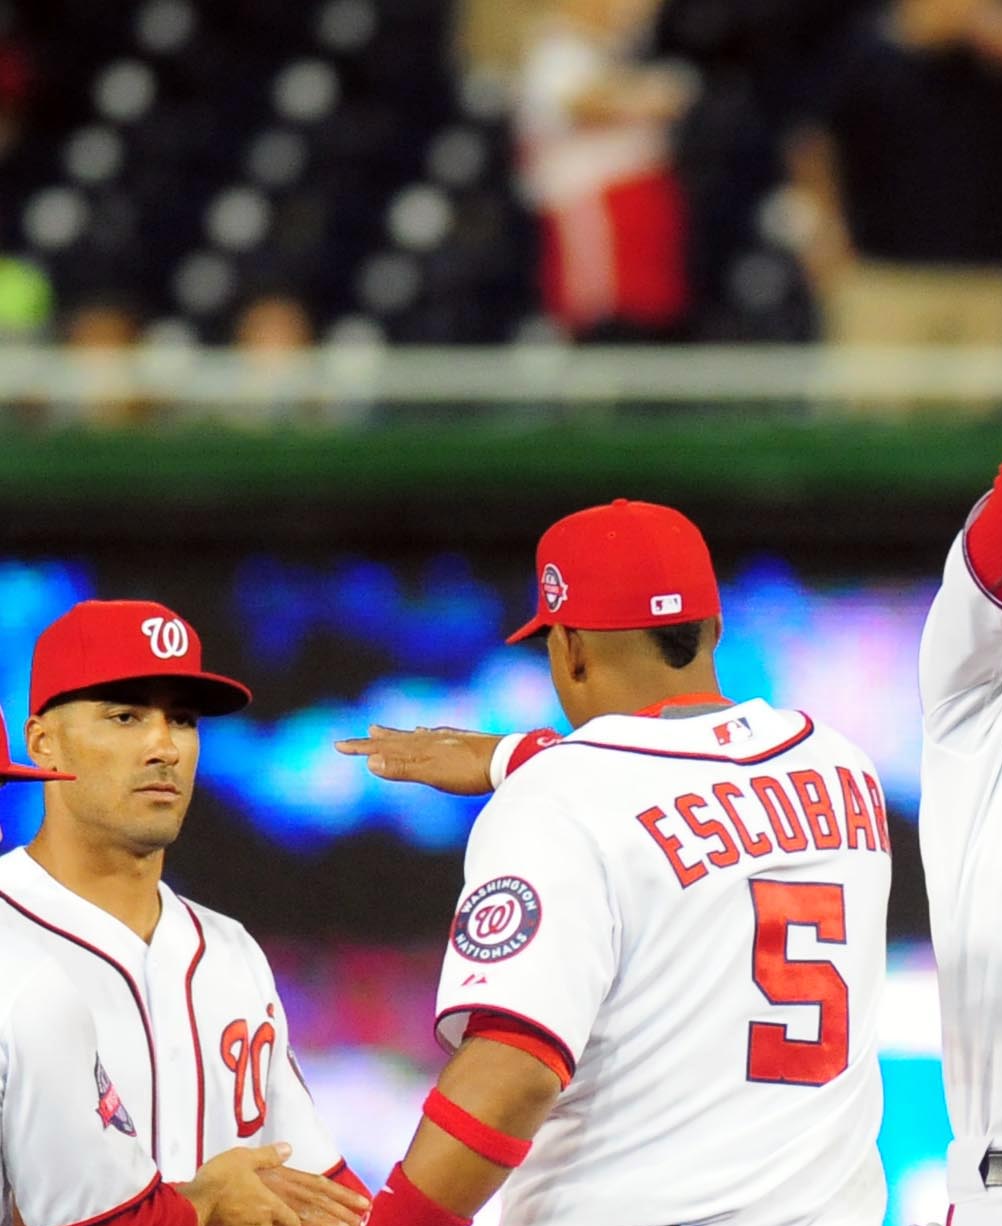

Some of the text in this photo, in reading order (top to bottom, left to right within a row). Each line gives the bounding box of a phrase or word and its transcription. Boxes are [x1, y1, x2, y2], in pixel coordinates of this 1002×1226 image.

[140, 616, 189, 660] W
[460, 878, 537, 914] WASHINGTON
[456, 933, 528, 959] NATIONALS
[746, 878, 849, 1086] 5
